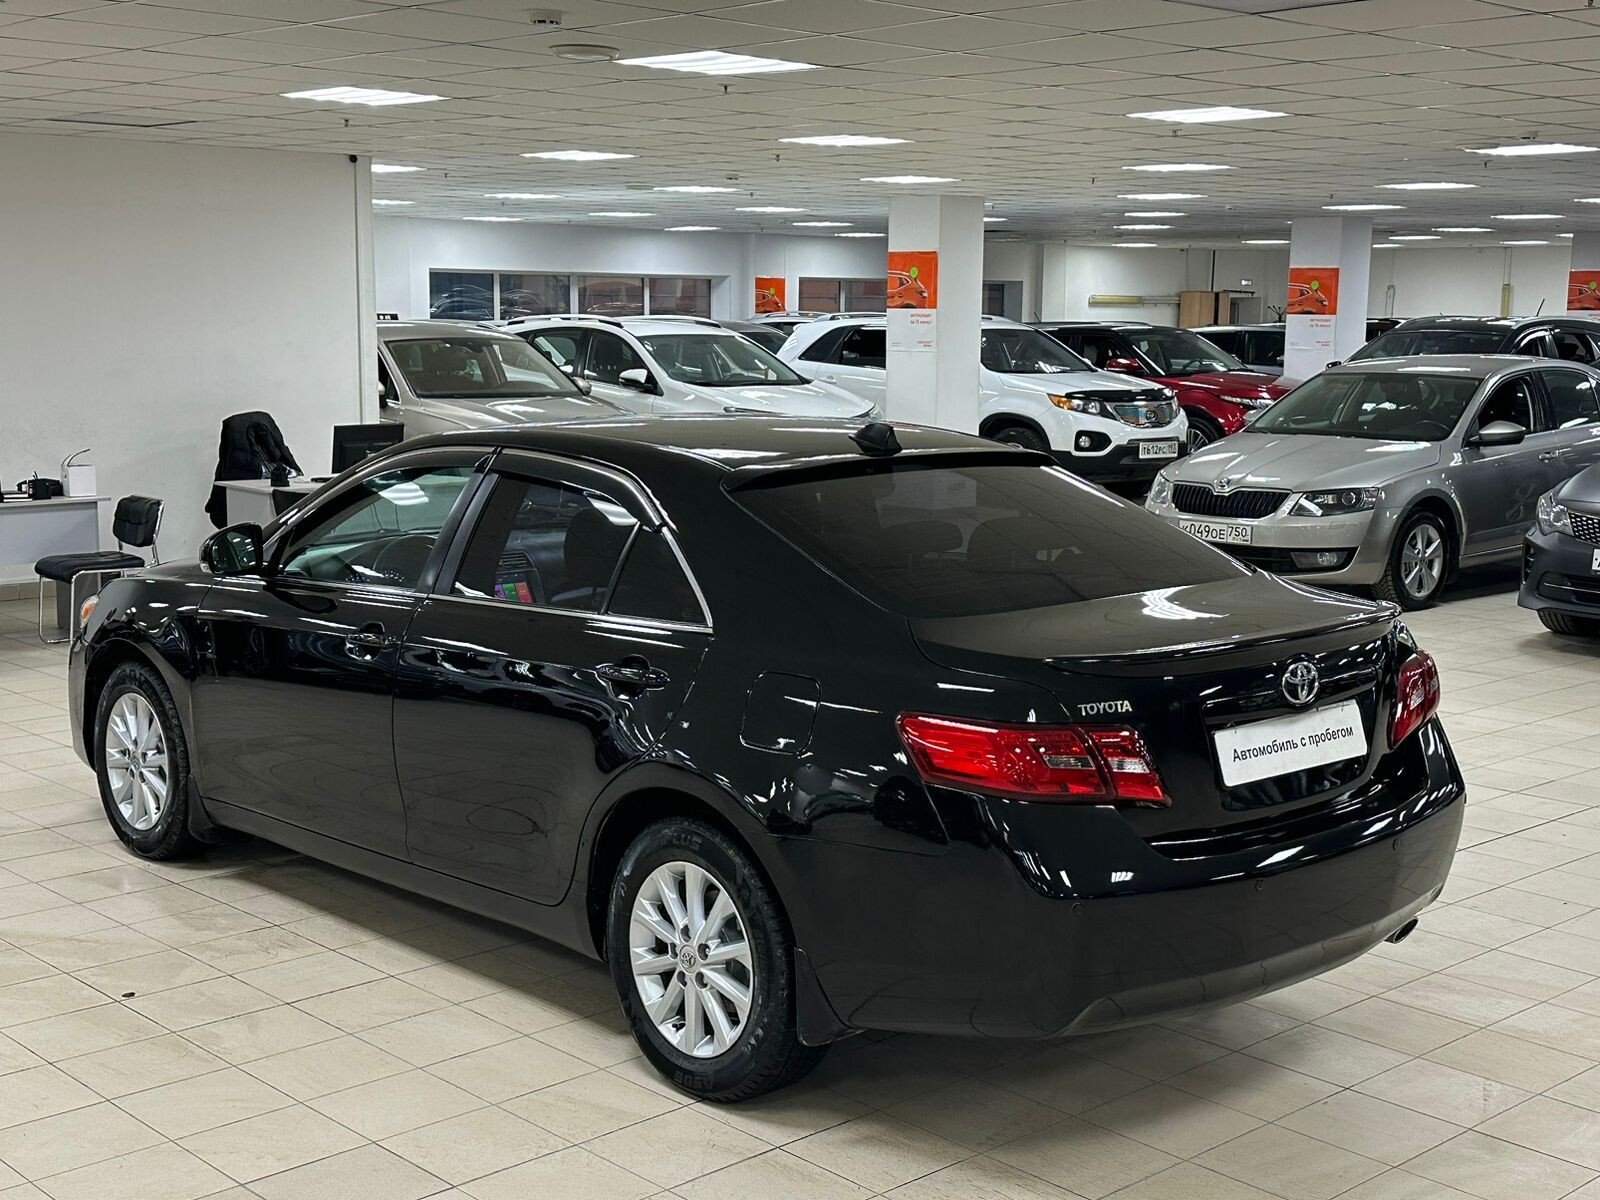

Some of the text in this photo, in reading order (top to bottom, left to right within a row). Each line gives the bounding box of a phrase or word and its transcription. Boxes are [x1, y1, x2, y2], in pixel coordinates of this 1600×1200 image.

[1078, 700, 1132, 717] TOYOTA
[1232, 726, 1354, 763] Автомобиль с пробегом
